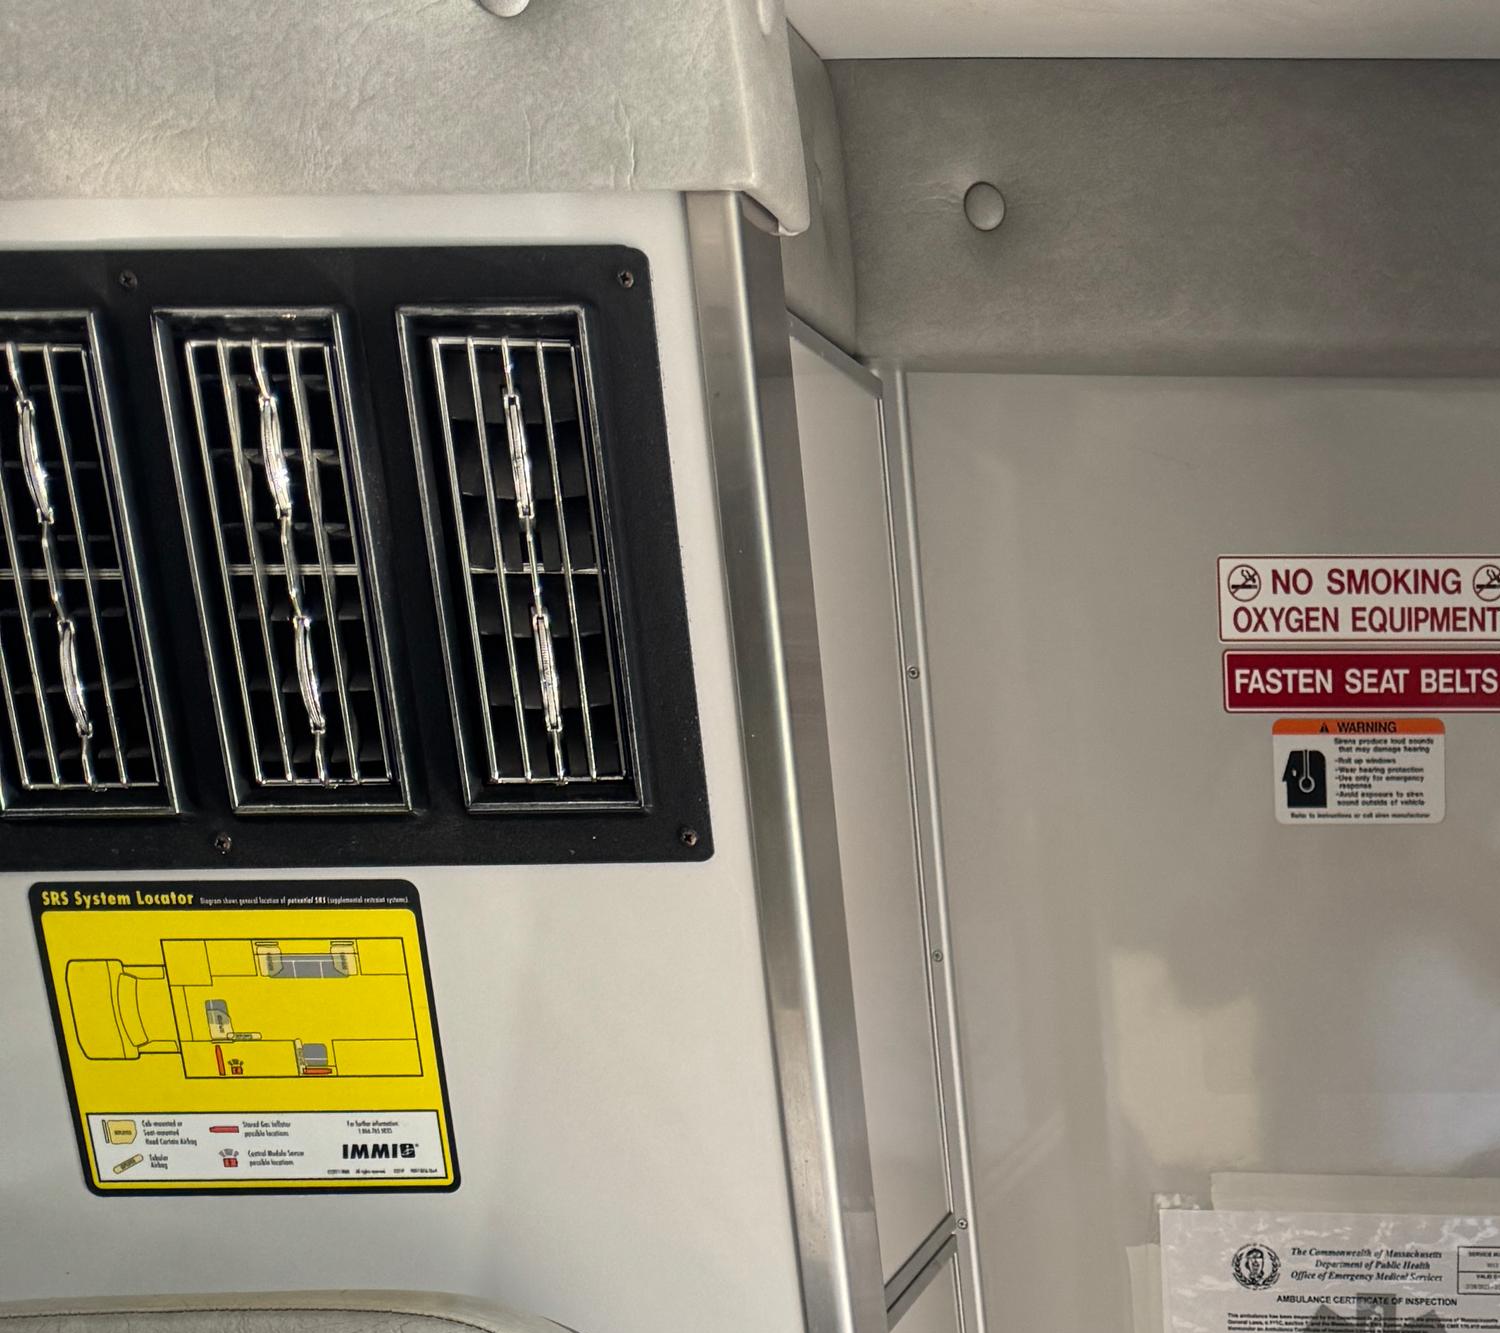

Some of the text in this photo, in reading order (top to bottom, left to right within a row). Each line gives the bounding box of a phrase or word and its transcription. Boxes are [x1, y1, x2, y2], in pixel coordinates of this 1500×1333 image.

[1272, 568, 1462, 595] NO SMOKING
[1233, 606, 1340, 633] OXYGEN
[1234, 669, 1499, 694] FASTEN SEAT BELTS
[1337, 722, 1397, 733] WARNING
[1359, 738, 1388, 746] produce
[1391, 737, 1406, 745] loud
[1409, 737, 1434, 745] sounds
[1373, 746, 1401, 754] damage
[1404, 746, 1430, 754] hearing
[1358, 766, 1385, 775] hearing
[1387, 767, 1424, 775] protection
[1355, 775, 1370, 783] only
[1372, 774, 1383, 782] for
[42, 890, 194, 909] SRS System Locator
[315, 896, 326, 904] SRS
[245, 1130, 265, 1138] possible
[180, 1138, 197, 1146] Airbag
[342, 1143, 398, 1160] IMMI
[151, 1162, 168, 1170] Airbag
[1291, 1248, 1442, 1259] The Commonwealth of Massachusetts
[1315, 1260, 1430, 1270] Department of Public Health
[1291, 1270, 1442, 1281] Office of Emergency Medical Services
[1276, 1295, 1457, 1306] AMBULANCE CERTIFICATE OF INSPECTION
